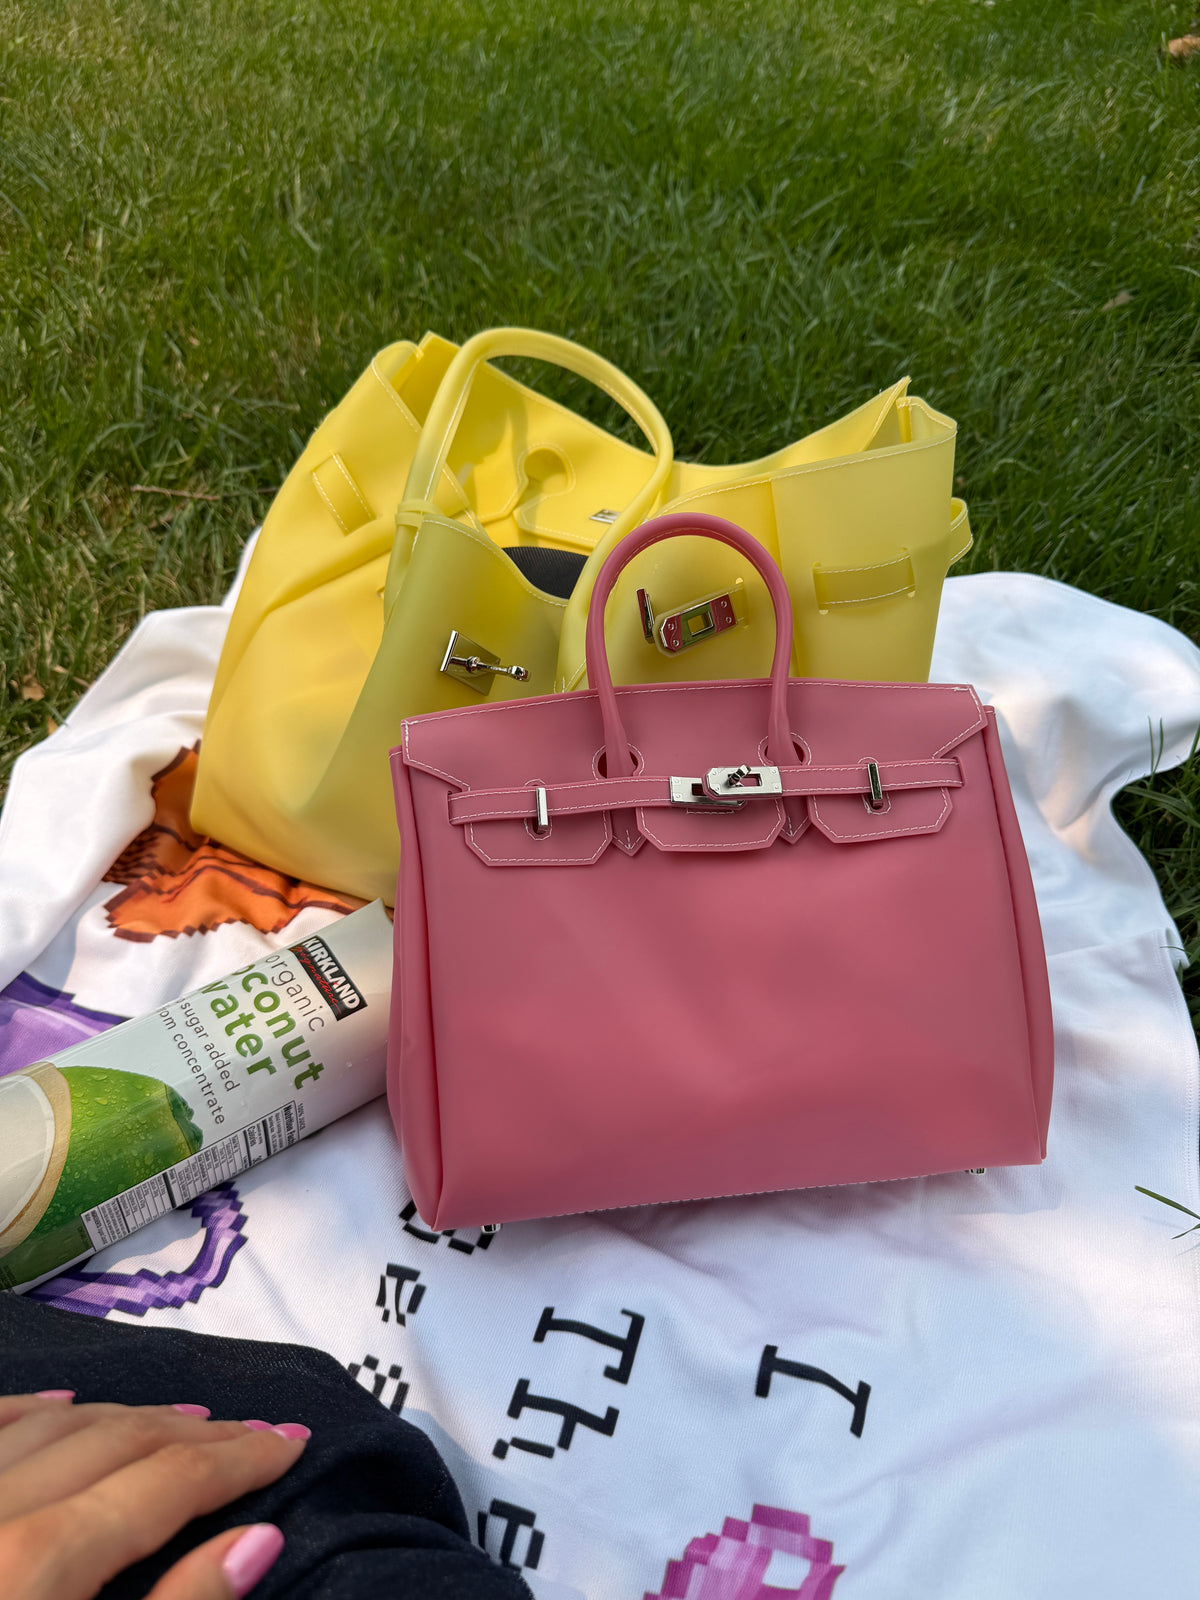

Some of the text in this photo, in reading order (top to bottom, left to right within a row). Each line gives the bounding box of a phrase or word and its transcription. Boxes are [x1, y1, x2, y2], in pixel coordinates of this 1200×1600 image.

[265, 954, 325, 1032] organic
[303, 937, 361, 1010] KIRKLAND
[173, 1032, 226, 1125] concentrate
[180, 998, 241, 1093] sugar added
[283, 1104, 294, 1132] Nutrition
